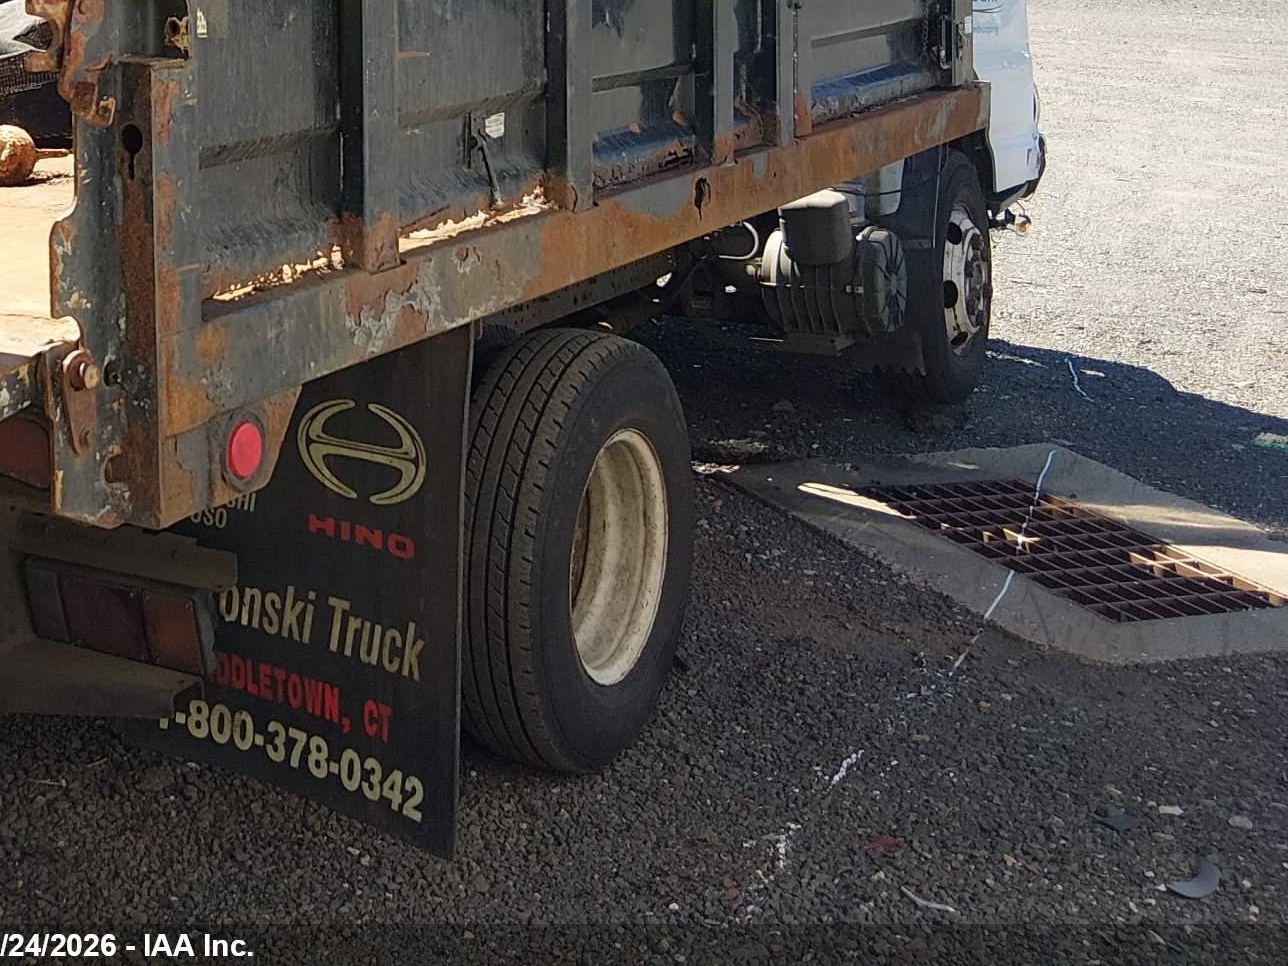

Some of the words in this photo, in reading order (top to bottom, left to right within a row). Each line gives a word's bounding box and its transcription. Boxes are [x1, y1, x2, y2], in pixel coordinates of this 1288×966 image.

[306, 514, 415, 560] HINO
[328, 595, 425, 682] Truck
[363, 699, 393, 746] CT
[160, 699, 424, 823] -800-378-0342
